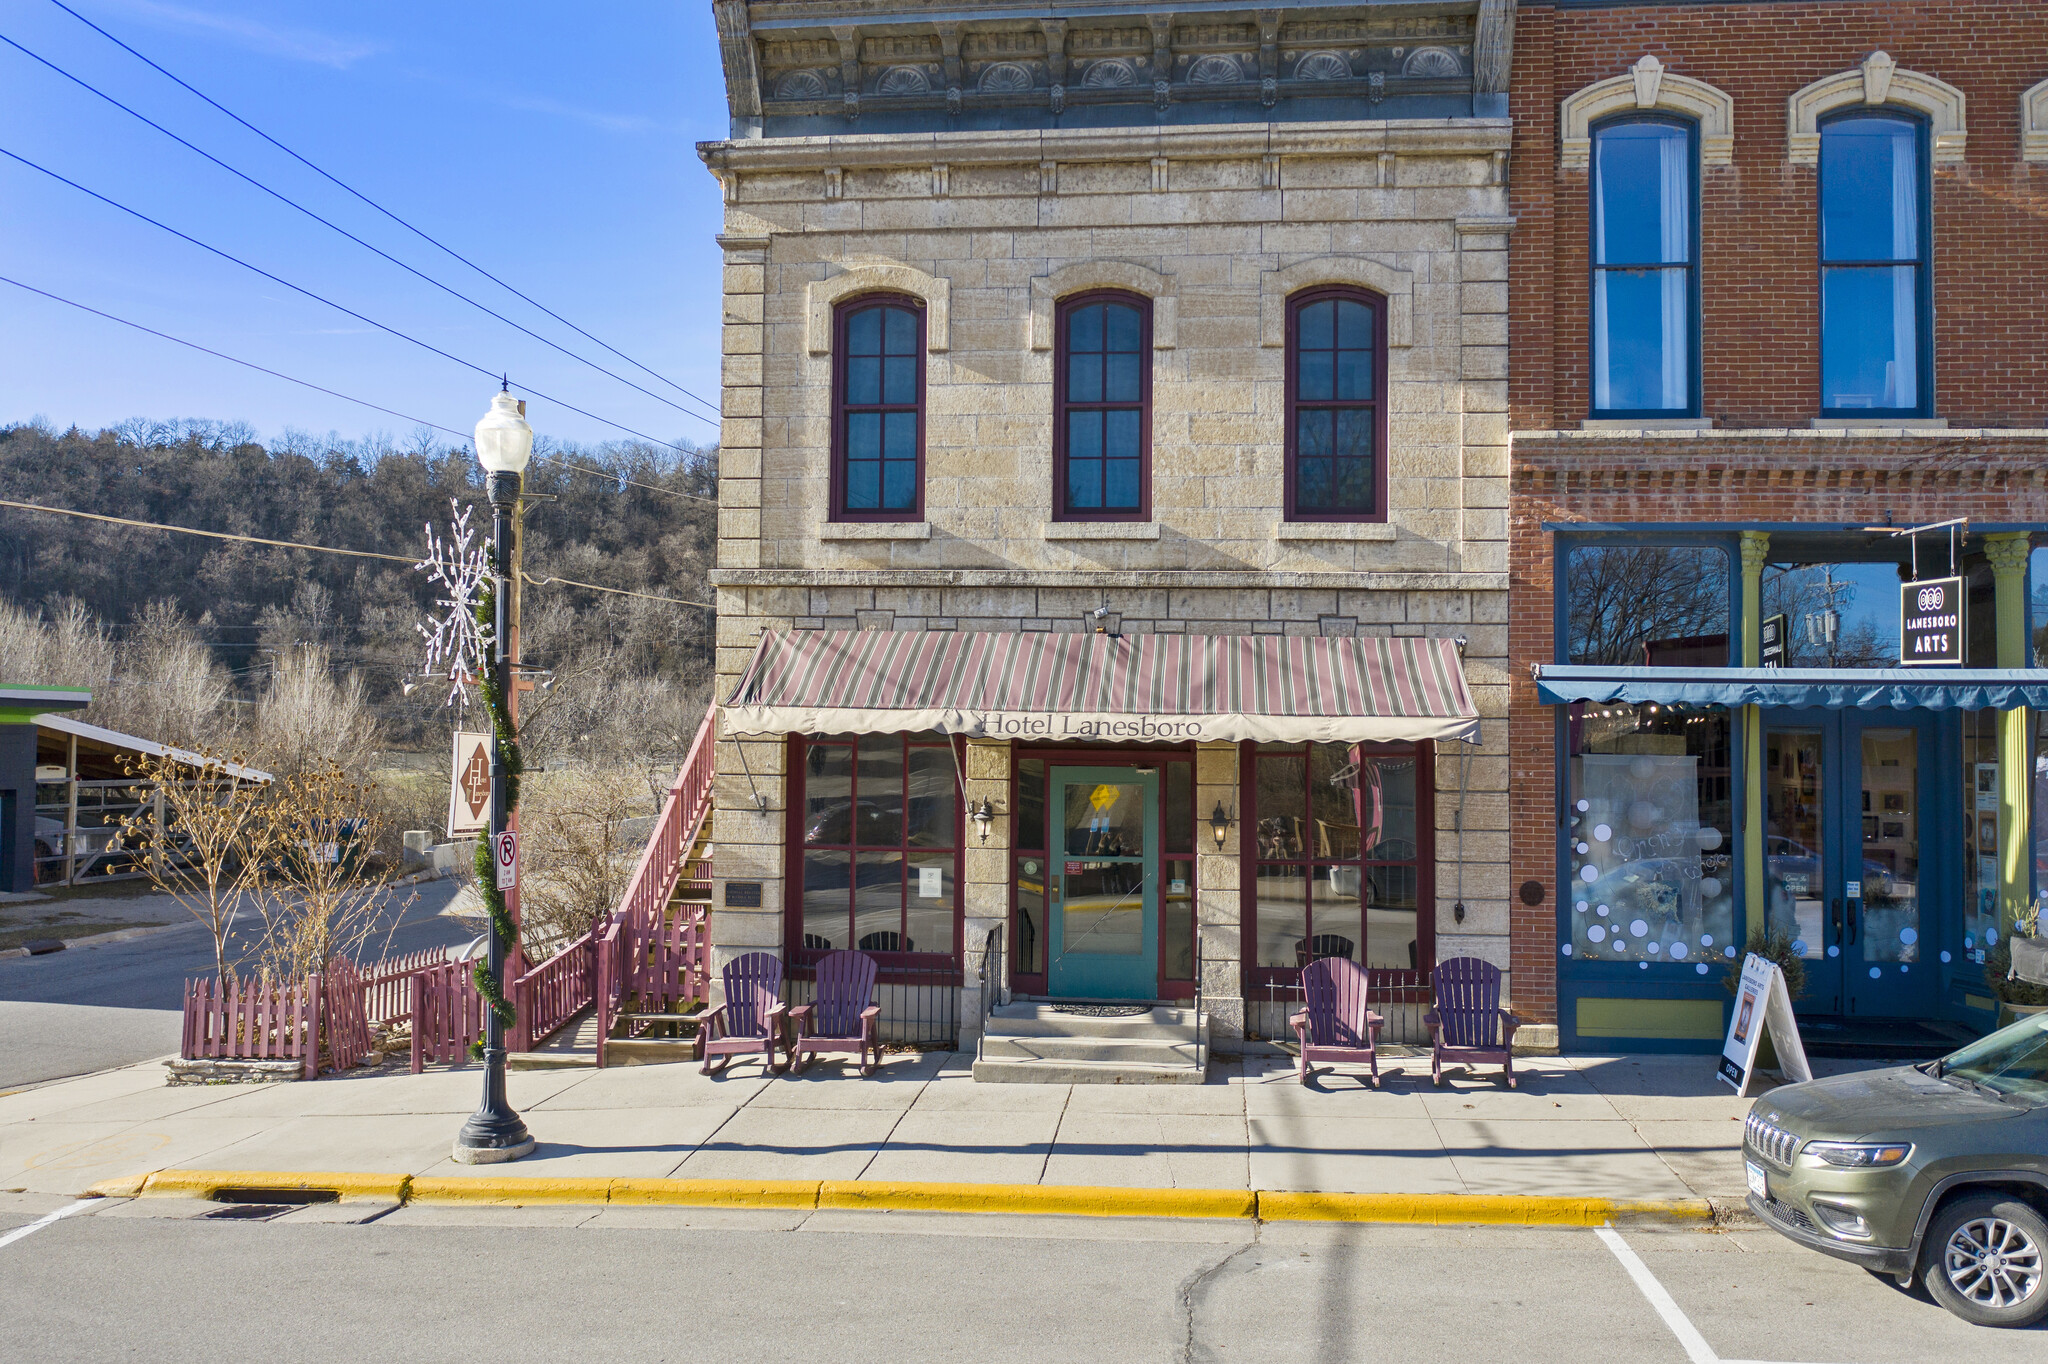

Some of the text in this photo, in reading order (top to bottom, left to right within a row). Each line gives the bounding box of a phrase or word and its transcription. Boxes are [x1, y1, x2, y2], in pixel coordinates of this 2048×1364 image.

[1907, 614, 1956, 630] LANESBORO
[1915, 634, 1948, 653] ARTS
[981, 713, 1203, 737] Hotel Lanesboro
[1785, 884, 1807, 893] OPEN
[1726, 1063, 1738, 1079] OPEN
